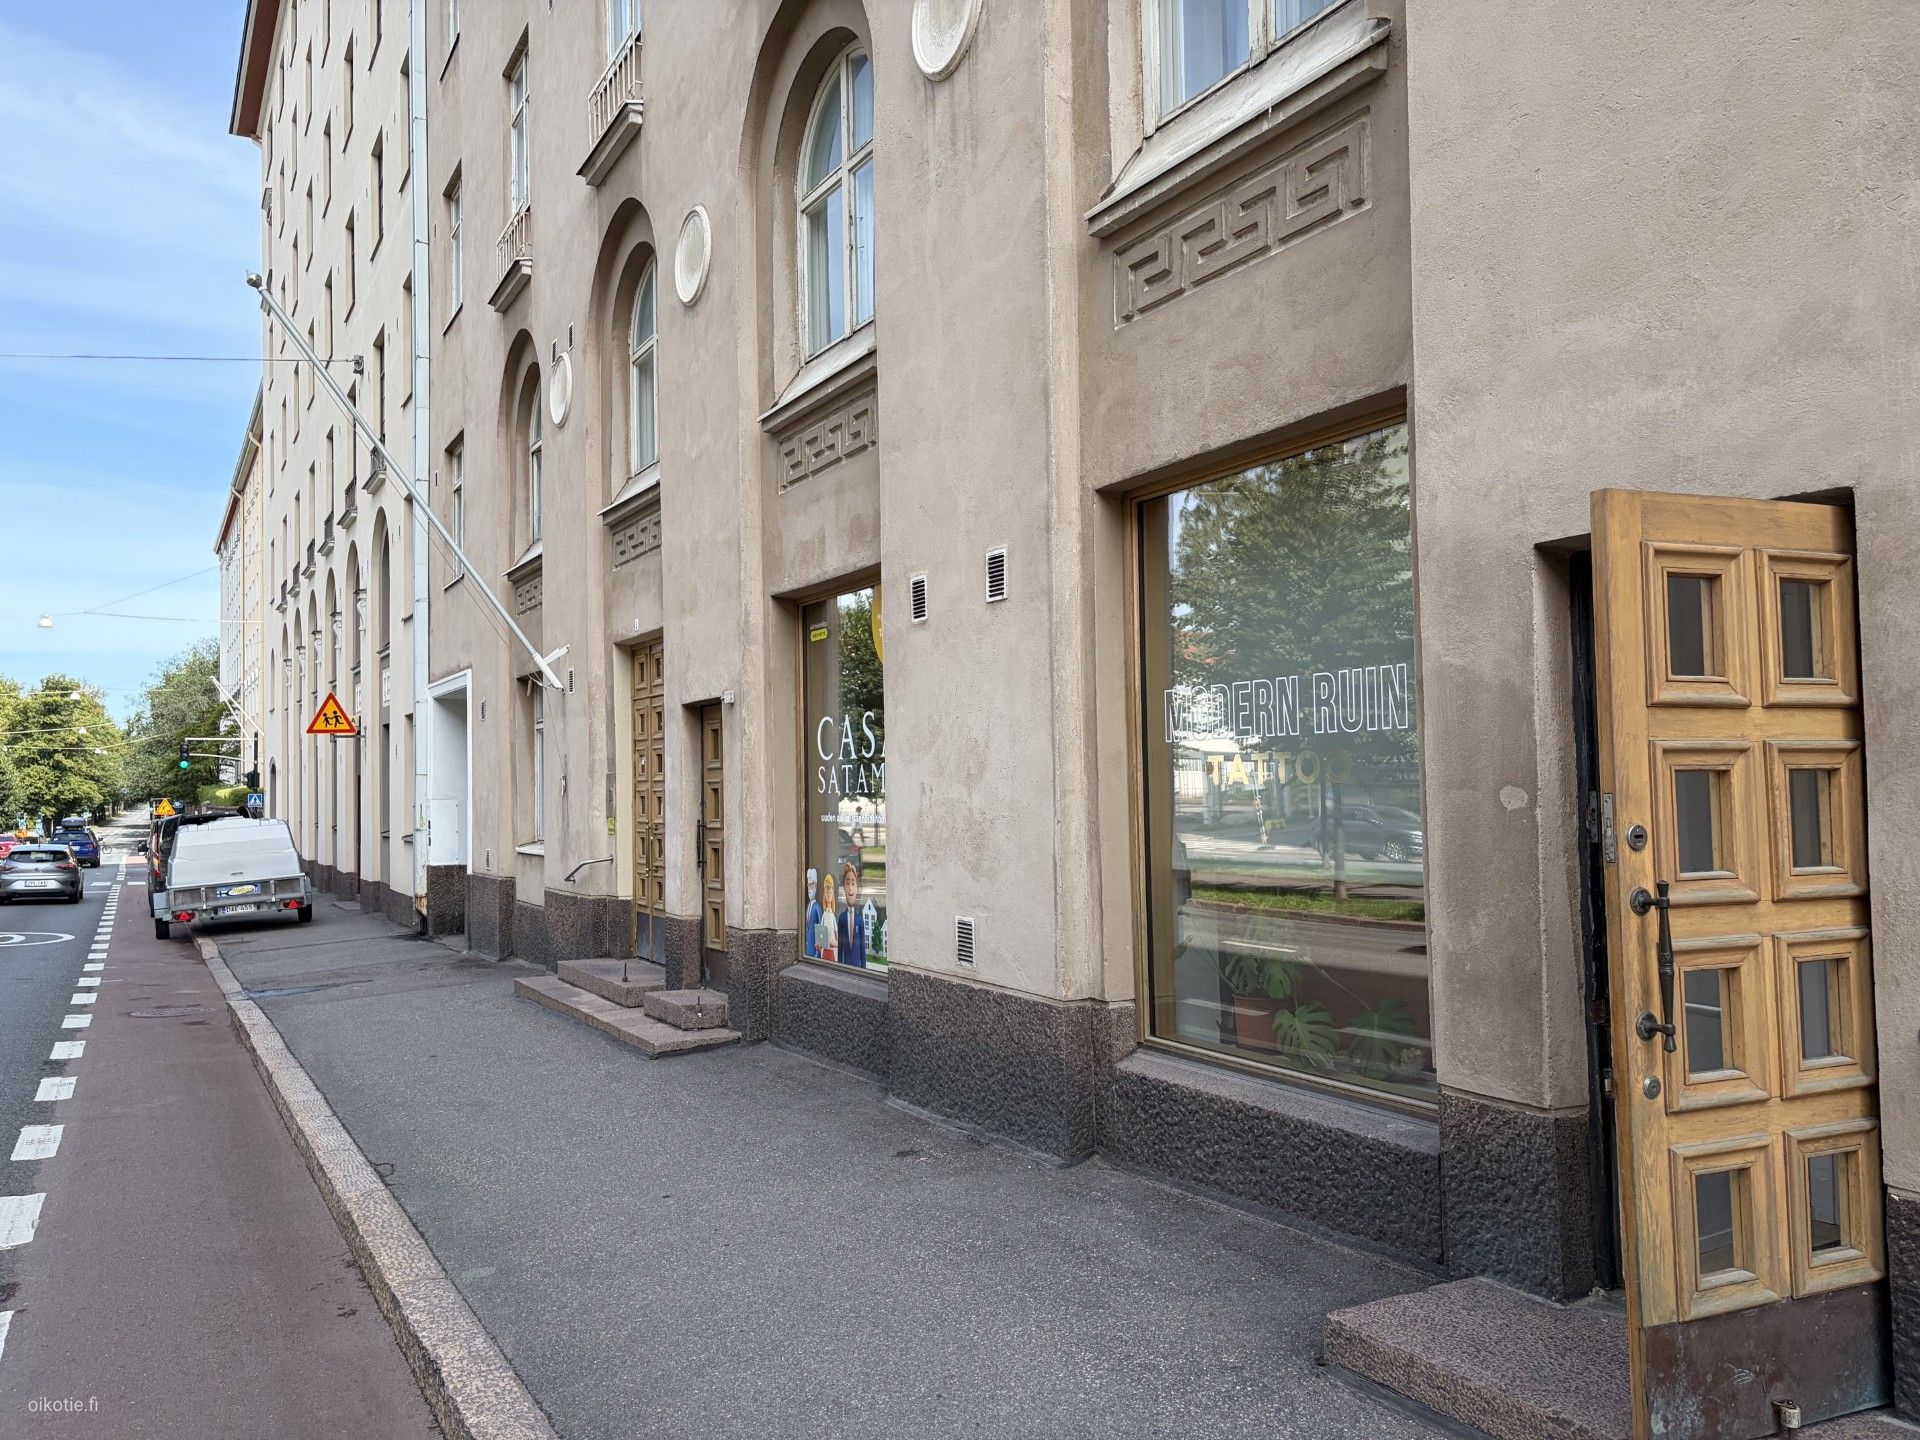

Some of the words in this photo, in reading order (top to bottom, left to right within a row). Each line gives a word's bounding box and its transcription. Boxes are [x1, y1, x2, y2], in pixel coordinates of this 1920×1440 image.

[1164, 676, 1300, 743] MODERN
[1312, 663, 1409, 734] RUIN
[1207, 750, 1352, 785] TATTOO
